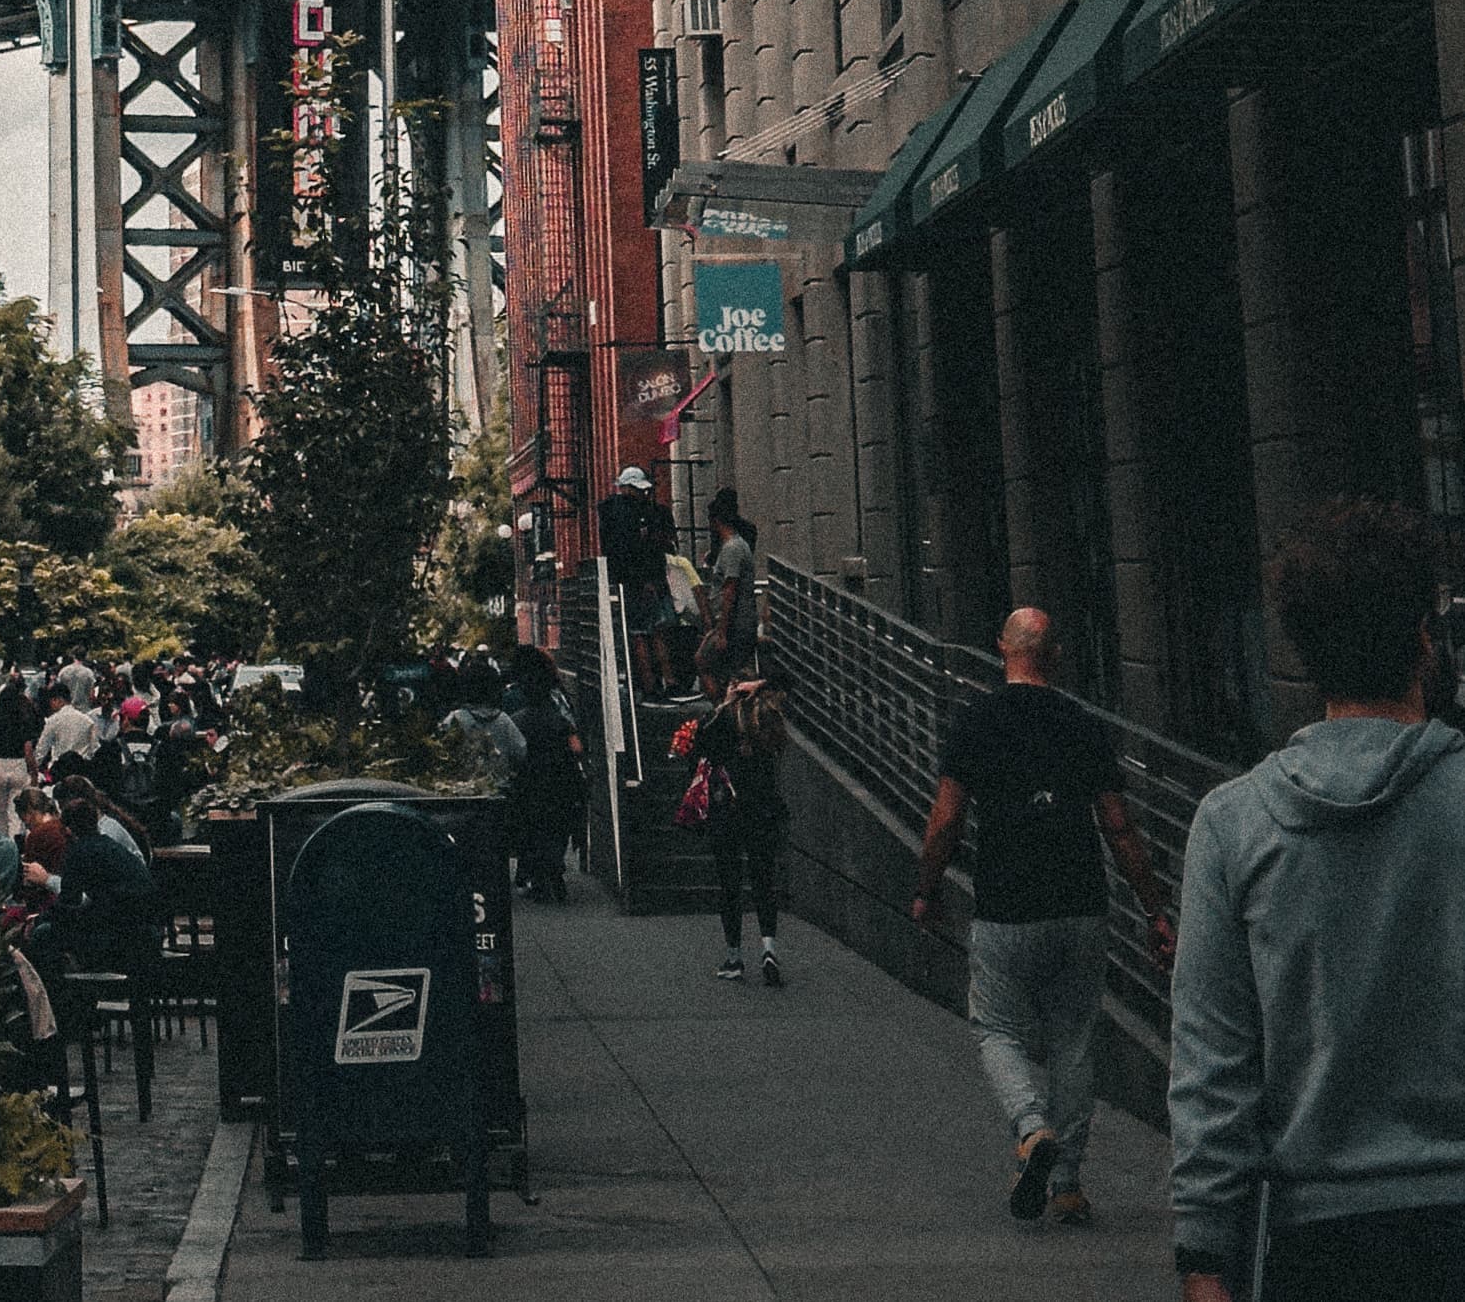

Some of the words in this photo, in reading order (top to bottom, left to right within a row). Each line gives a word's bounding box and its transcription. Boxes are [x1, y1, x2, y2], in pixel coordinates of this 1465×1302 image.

[644, 56, 657, 71] 55
[644, 75, 659, 150] Washington
[647, 152, 661, 169] St.
[716, 306, 767, 333] Joe
[698, 328, 785, 352] Coffee
